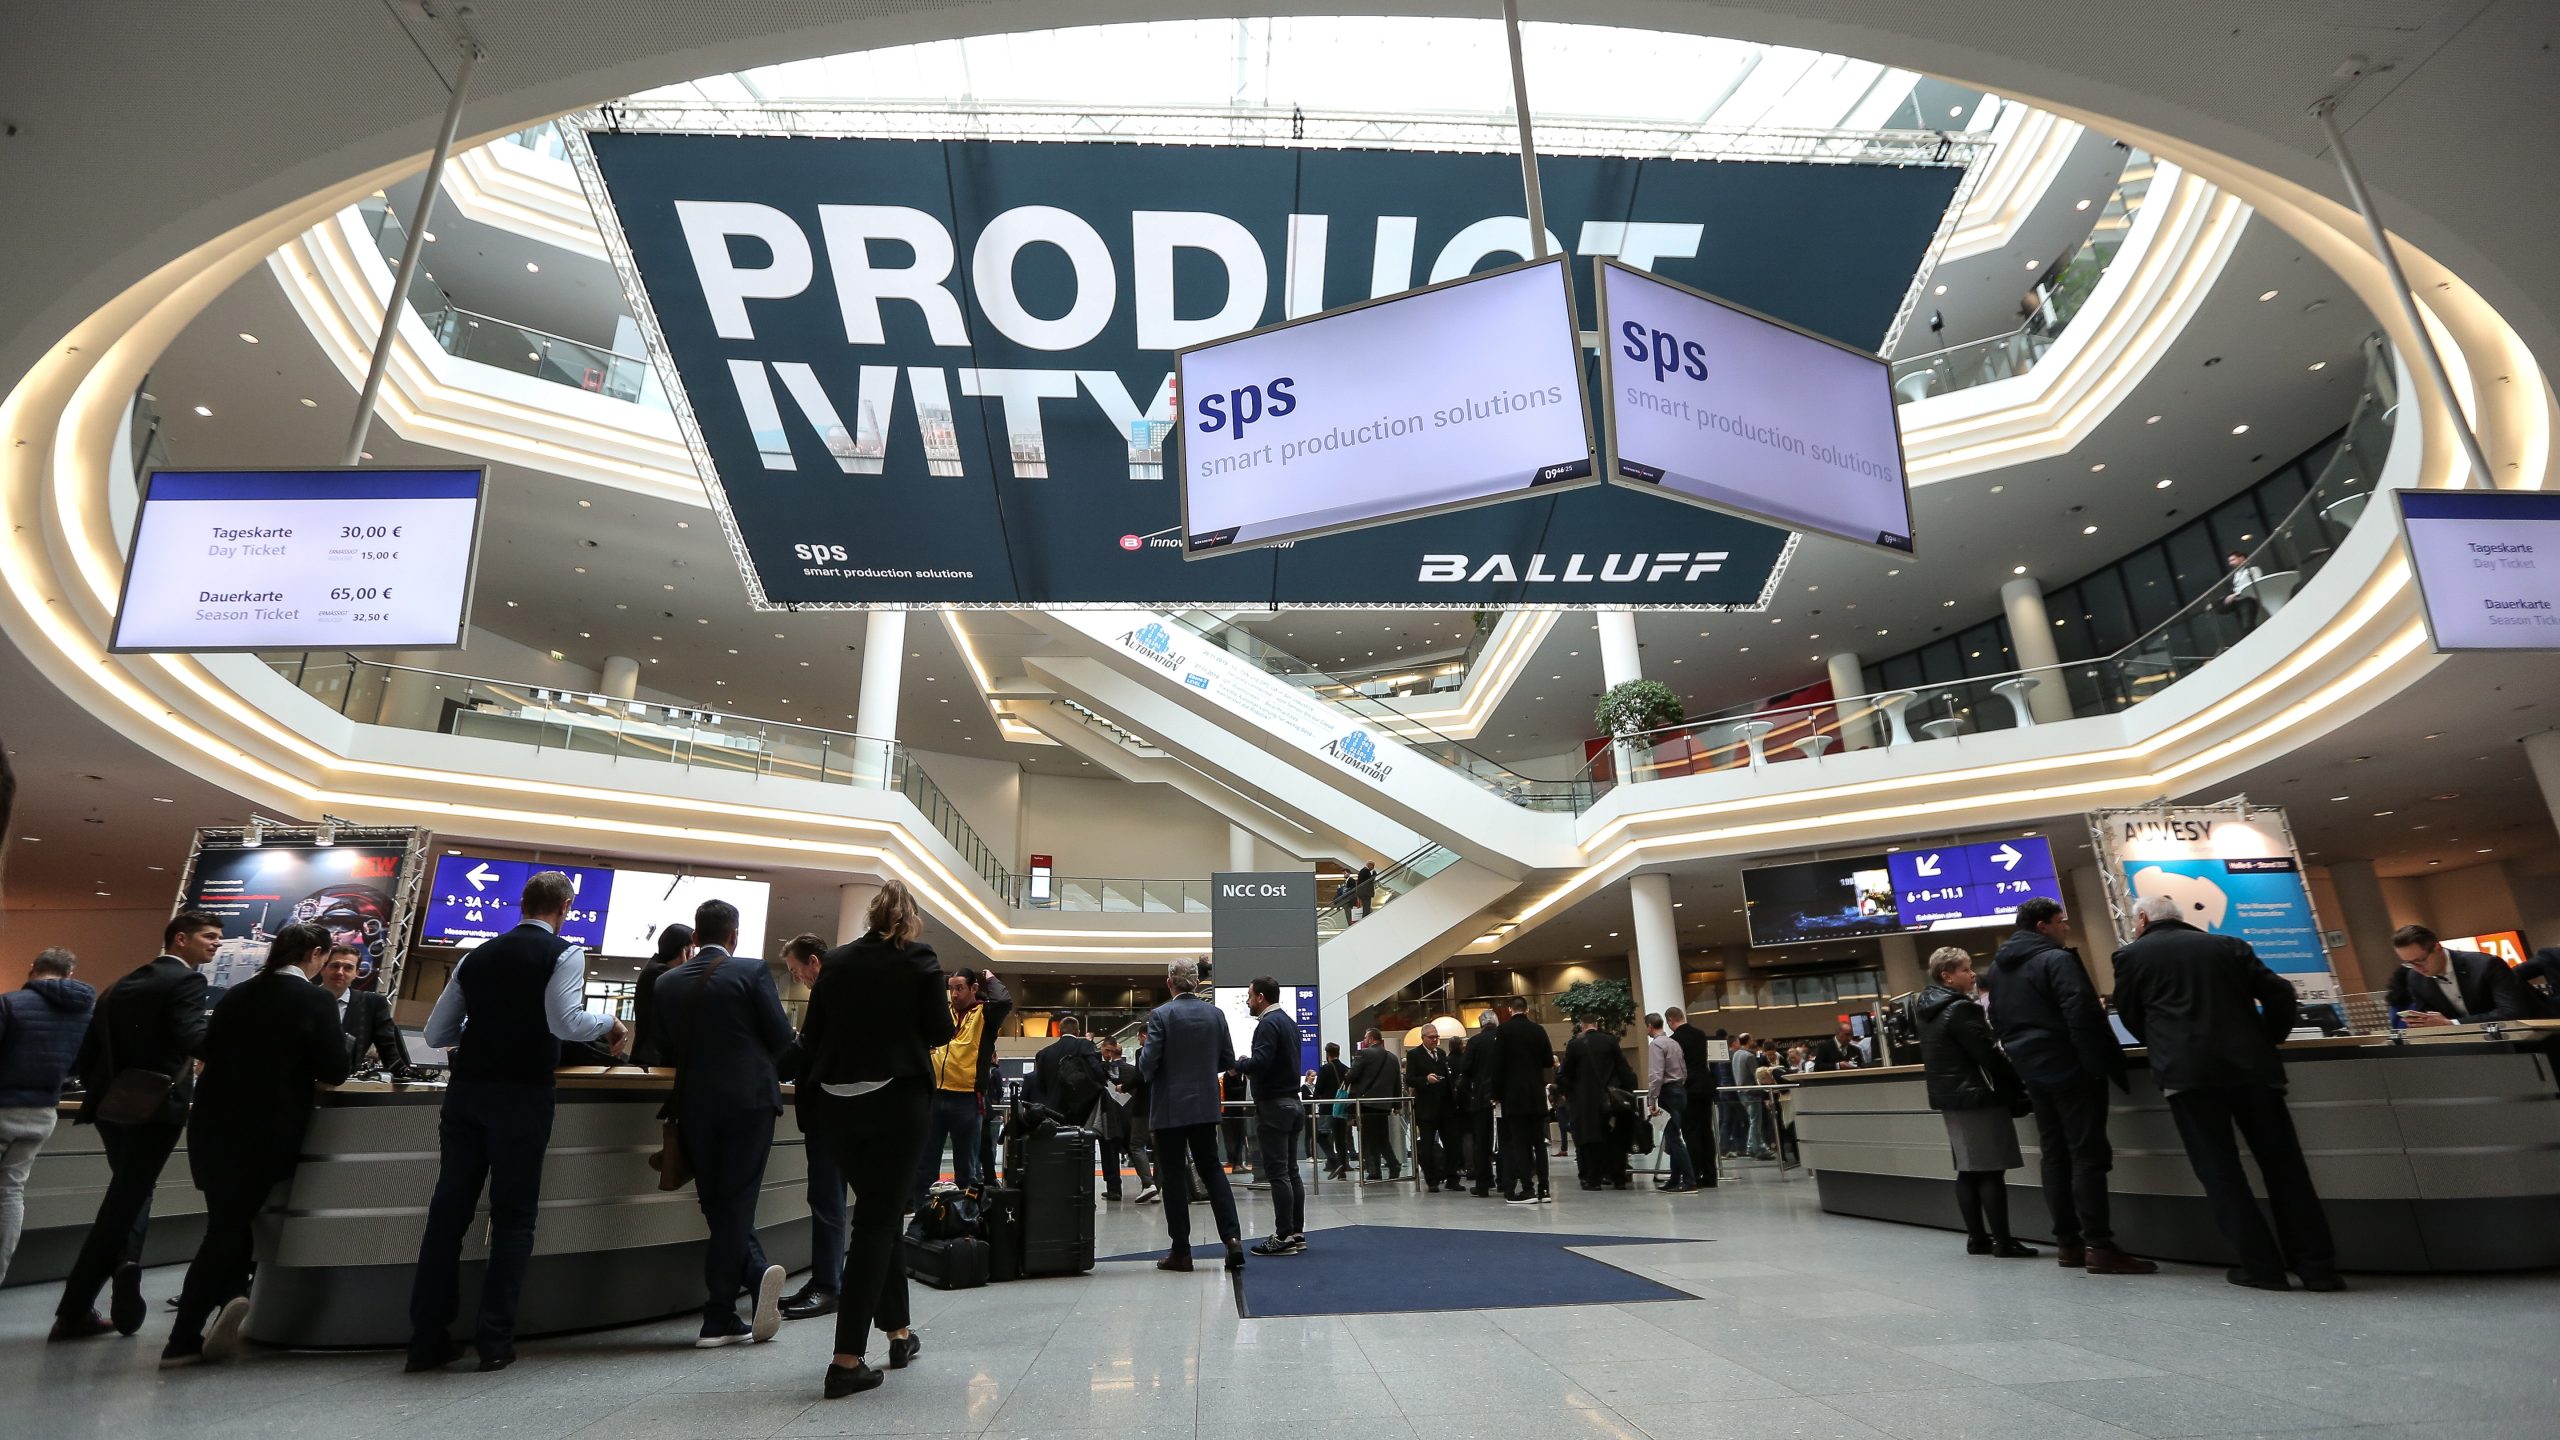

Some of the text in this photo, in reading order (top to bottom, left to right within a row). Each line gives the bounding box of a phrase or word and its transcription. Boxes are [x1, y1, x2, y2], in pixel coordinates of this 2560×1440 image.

[1622, 320, 1709, 382] sps
[1198, 374, 1297, 440] sps
[727, 358, 1178, 480] IVITY
[1201, 385, 1563, 478] smart production solutions
[1627, 385, 1893, 483] smart production solutions
[212, 526, 402, 541] Tageskarte 30,00 €
[208, 544, 287, 558] Day Ticket
[361, 551, 390, 561] 15,00
[392, 551, 399, 560] €
[795, 543, 848, 565] sps
[2468, 542, 2534, 556] Tageskarte
[1418, 551, 1729, 582] BALLUFF
[2473, 558, 2536, 571] Day Ticket
[803, 567, 974, 579] smart production solutions
[199, 587, 393, 603] Dauerkarte 65,00 €
[2484, 599, 2552, 610] Dauerkarte
[195, 608, 300, 621] Season Ticket
[353, 613, 380, 623] 32,50
[383, 613, 390, 622] €
[2488, 615, 2531, 626] Season
[1115, 630, 1179, 672] AUTOMATION
[1168, 651, 1186, 666] 4.0
[1320, 739, 1386, 782] AUTOMATION
[1374, 761, 1393, 776] 4.0
[2126, 820, 2213, 841] AUVESY
[1223, 884, 1287, 897] NCC Ost
[465, 896, 482, 908] 3A
[465, 910, 483, 922] 4A
[588, 910, 597, 923] 5
[2480, 939, 2523, 966] 7A
[1299, 990, 1314, 999] sps
